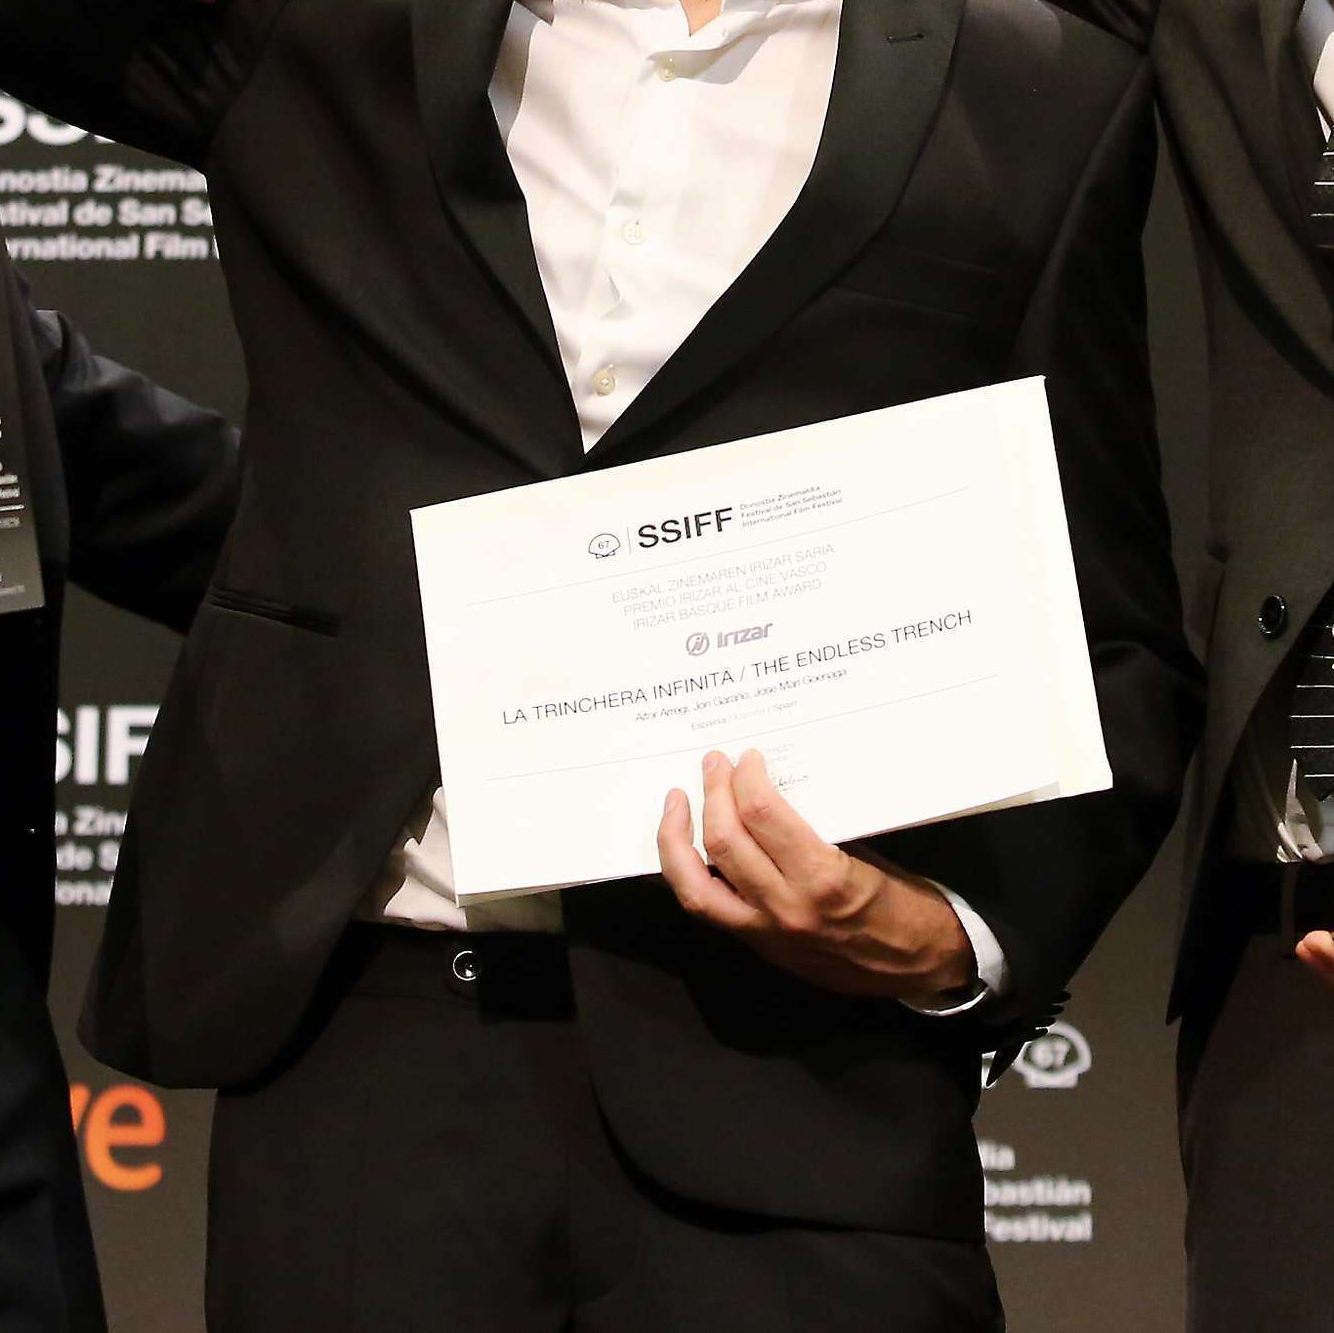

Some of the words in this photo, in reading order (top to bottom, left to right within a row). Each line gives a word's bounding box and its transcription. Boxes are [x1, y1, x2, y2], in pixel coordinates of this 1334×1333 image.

[73, 199, 113, 226] de
[117, 197, 177, 226] San
[144, 232, 209, 259] Film
[597, 540, 611, 551] 67
[638, 507, 733, 548] SSIFF
[611, 586, 662, 603] EUSKAL
[667, 568, 748, 591] ZINEMAREN
[749, 555, 794, 572] IRIZAR
[794, 544, 836, 562] SARIA
[622, 598, 677, 617] PREMIO
[679, 587, 723, 604] IRIZAR
[725, 581, 743, 595] AL
[744, 576, 776, 590] CINE
[777, 563, 828, 581] VASCO
[631, 613, 678, 630] IRIZAR
[678, 600, 736, 620] BASQUE
[738, 592, 770, 608] FILM
[770, 580, 823, 600] AWARD
[502, 707, 527, 726] LA
[533, 689, 648, 721] TRINCHERA
[653, 667, 735, 698] INFINITA
[752, 657, 791, 678] THE
[796, 634, 887, 667] ENDLESS
[891, 611, 973, 644] TRENCH
[985, 1210, 1092, 1242] estival
